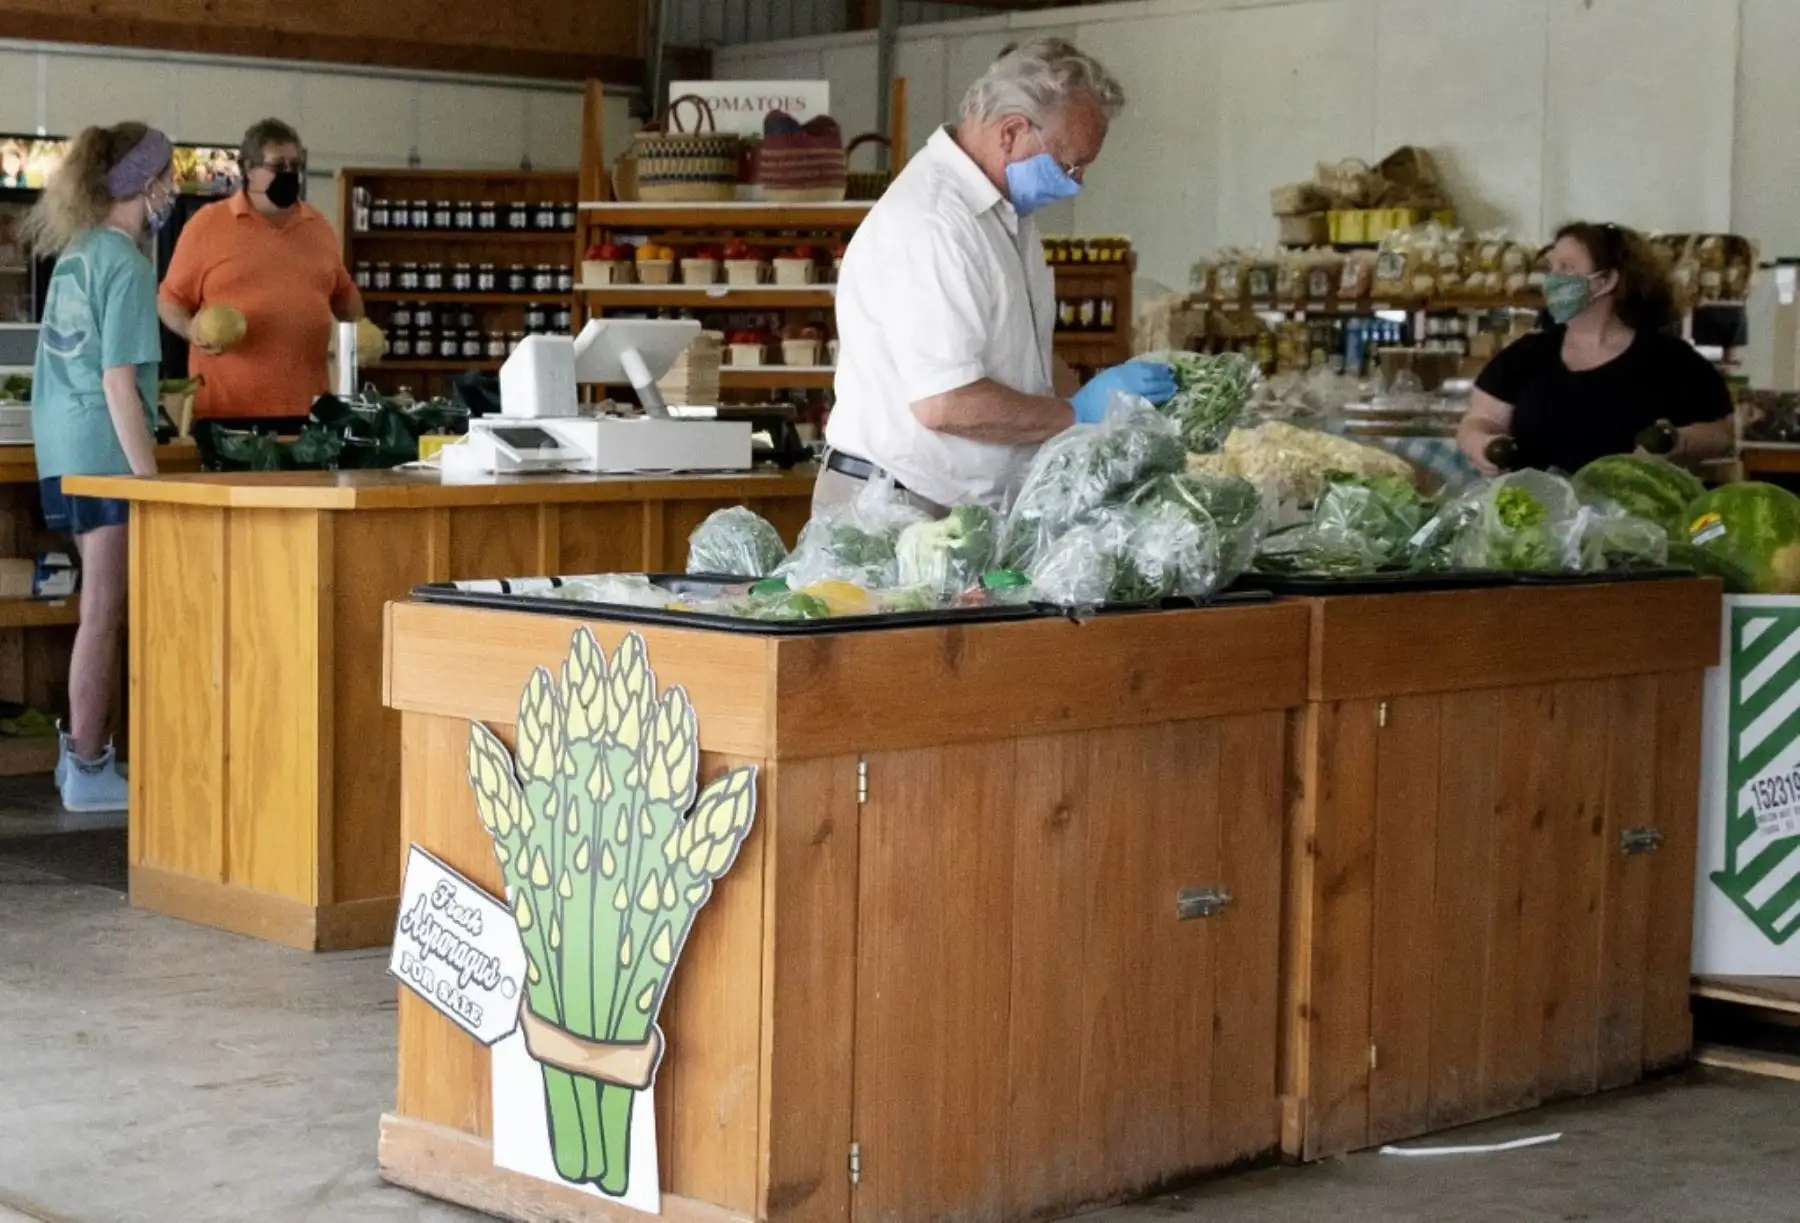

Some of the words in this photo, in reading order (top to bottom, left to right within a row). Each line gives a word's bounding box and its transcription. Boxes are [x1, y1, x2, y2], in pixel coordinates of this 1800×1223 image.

[697, 95, 807, 112] OMATOES
[431, 879, 483, 936] Fresh
[400, 893, 501, 991] Asparagus
[400, 951, 436, 993] FOR
[436, 979, 484, 1029] SALE
